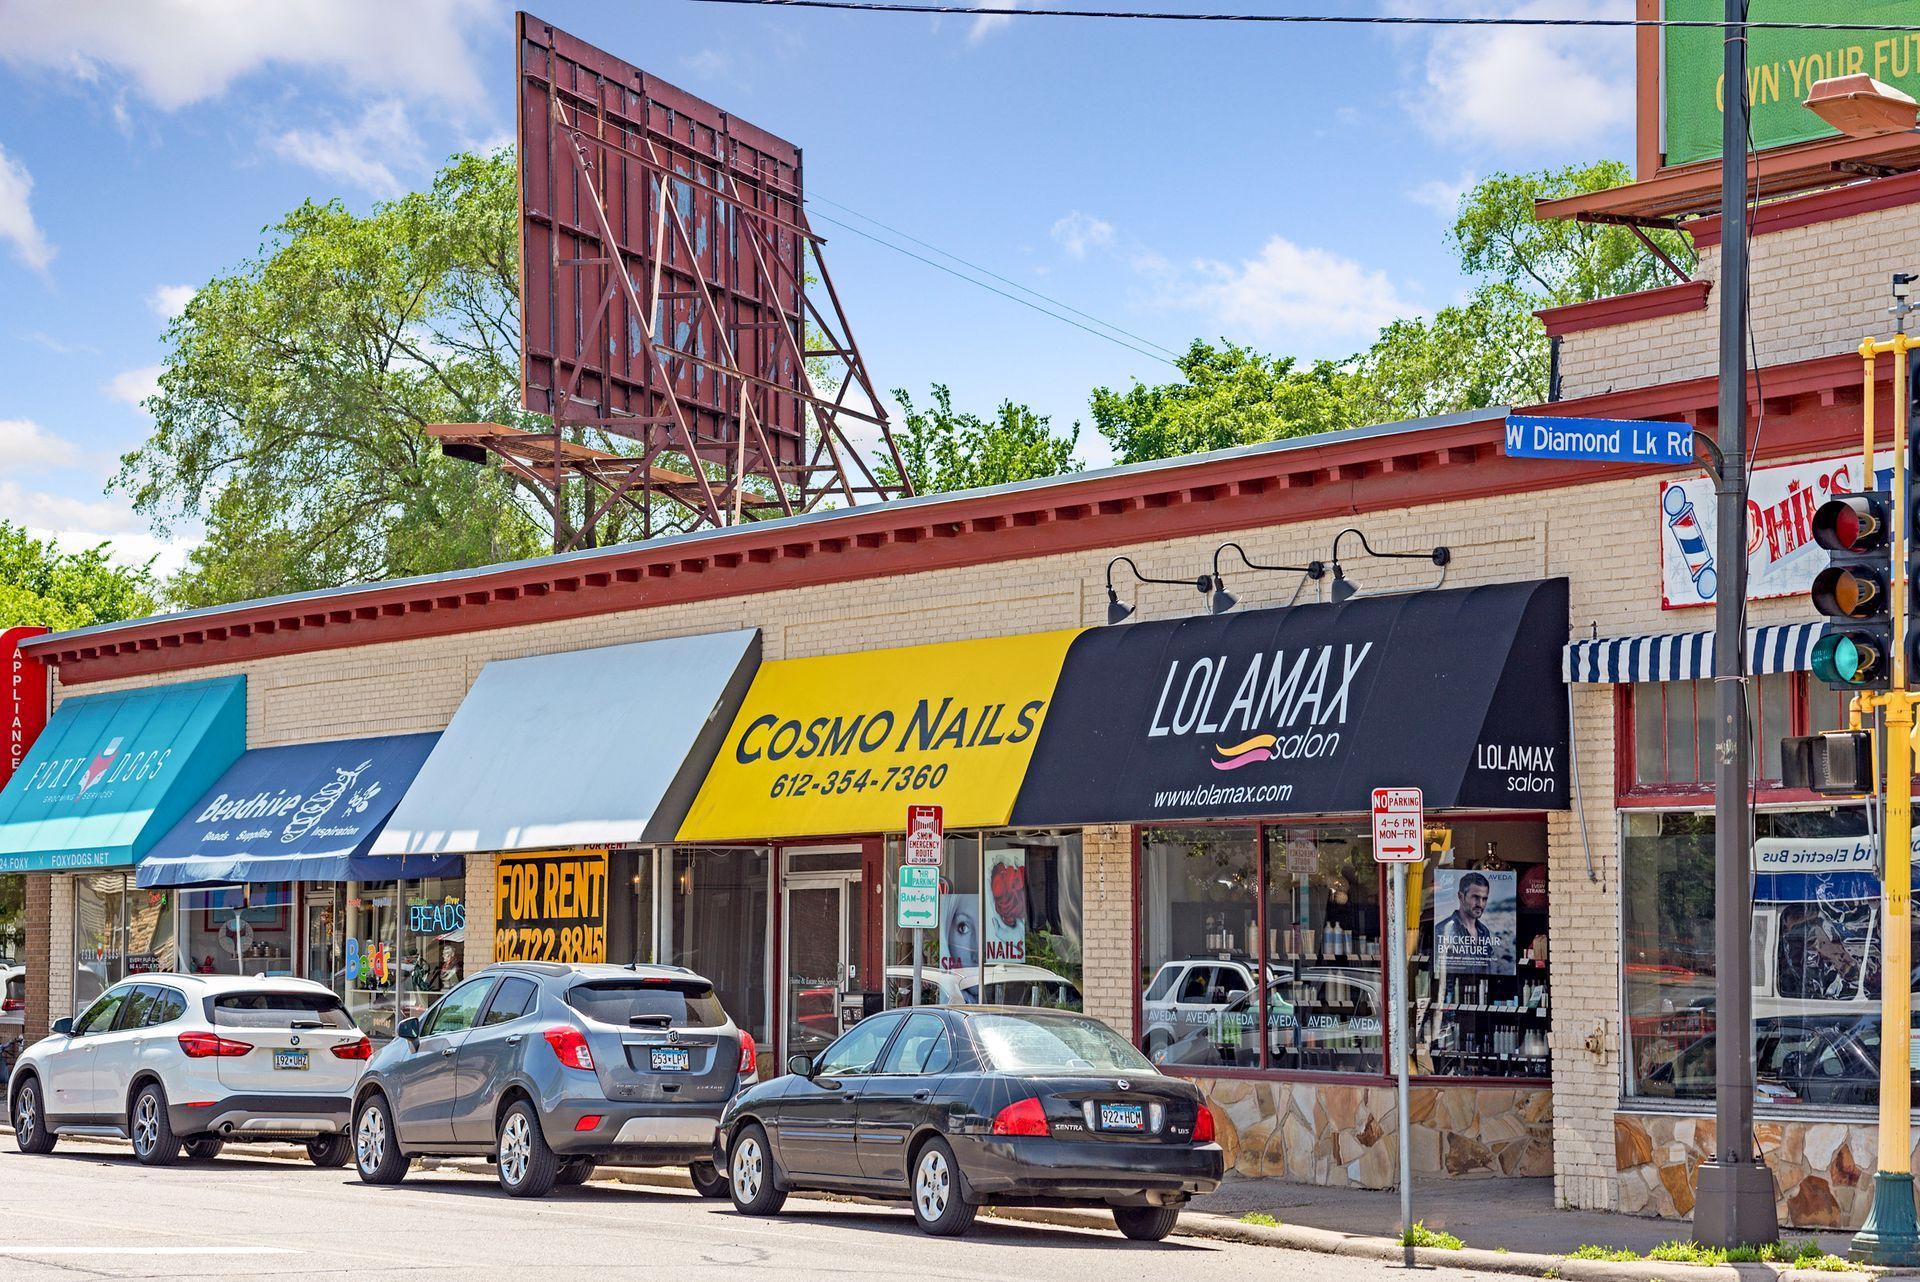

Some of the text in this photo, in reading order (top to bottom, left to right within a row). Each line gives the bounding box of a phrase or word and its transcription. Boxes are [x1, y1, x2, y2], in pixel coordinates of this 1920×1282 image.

[1788, 46, 1863, 98] YOUR
[1506, 425, 1692, 457] W Diamond Lk Rd
[1147, 641, 1373, 738] LOLAMAX
[736, 697, 1046, 765] COSMO NAILS
[1270, 726, 1340, 760] salon
[1478, 744, 1555, 773] LOLAMAX
[24, 749, 171, 791] FOXY DOGS
[770, 763, 949, 799] 612-354-7360
[1507, 773, 1555, 793] salon
[1154, 782, 1293, 809] www.lolamax.com
[1374, 795, 1419, 809] NO PARKING
[196, 789, 301, 823] Beadhive
[1402, 818, 1415, 828] PM
[236, 828, 272, 842] Supplies
[311, 826, 360, 839] Inspiration
[917, 832, 932, 840] SNOW
[1379, 830, 1417, 839] MON-FRI
[909, 841, 939, 849] EMERGENCY
[52, 853, 109, 867] FOXYDOGS.NET
[915, 849, 933, 858] ROUTE
[919, 870, 929, 878] HR
[911, 878, 935, 886] PARKING
[497, 861, 605, 920] FOR RENT
[901, 892, 936, 902] 8AM-6PM
[410, 903, 465, 932] BEADS
[1438, 935, 1501, 946] THICKER HAIR
[987, 940, 1024, 959] NAILS
[1438, 945, 1488, 955] BY NATURE
[346, 937, 391, 985] Beads
[1148, 1010, 1177, 1022] AVEDA
[1185, 1012, 1215, 1024] AVEDA
[1224, 1014, 1254, 1026] AVEDA
[1267, 1015, 1298, 1027] AVEDA
[1307, 1016, 1339, 1028] AVEDA
[1348, 1018, 1381, 1031] AVEDA
